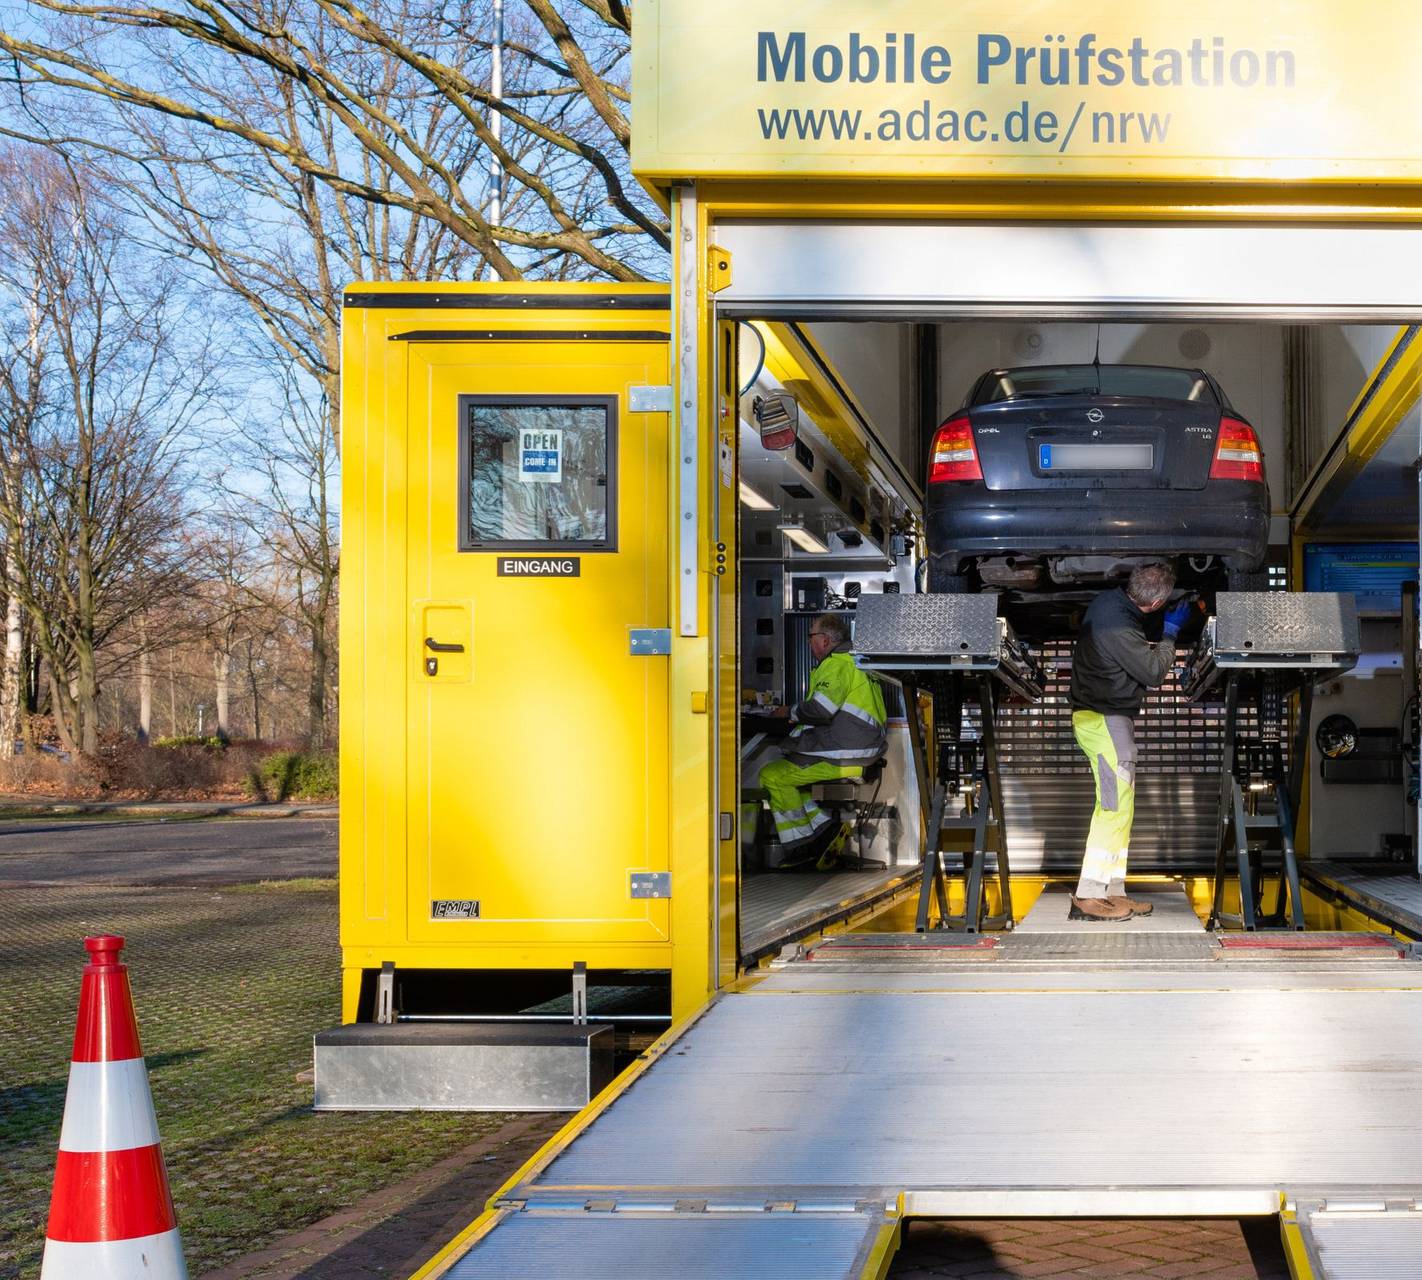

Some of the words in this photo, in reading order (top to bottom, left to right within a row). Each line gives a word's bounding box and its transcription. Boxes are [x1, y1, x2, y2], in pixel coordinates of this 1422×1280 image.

[757, 31, 952, 84] Mobile
[976, 33, 1295, 87] Prüfstation
[757, 100, 1172, 152] www.adac.de/nrw
[523, 433, 558, 450] OPEN
[524, 457, 546, 466] COME
[503, 560, 574, 574] EINGANG
[434, 901, 478, 917] EMPL
